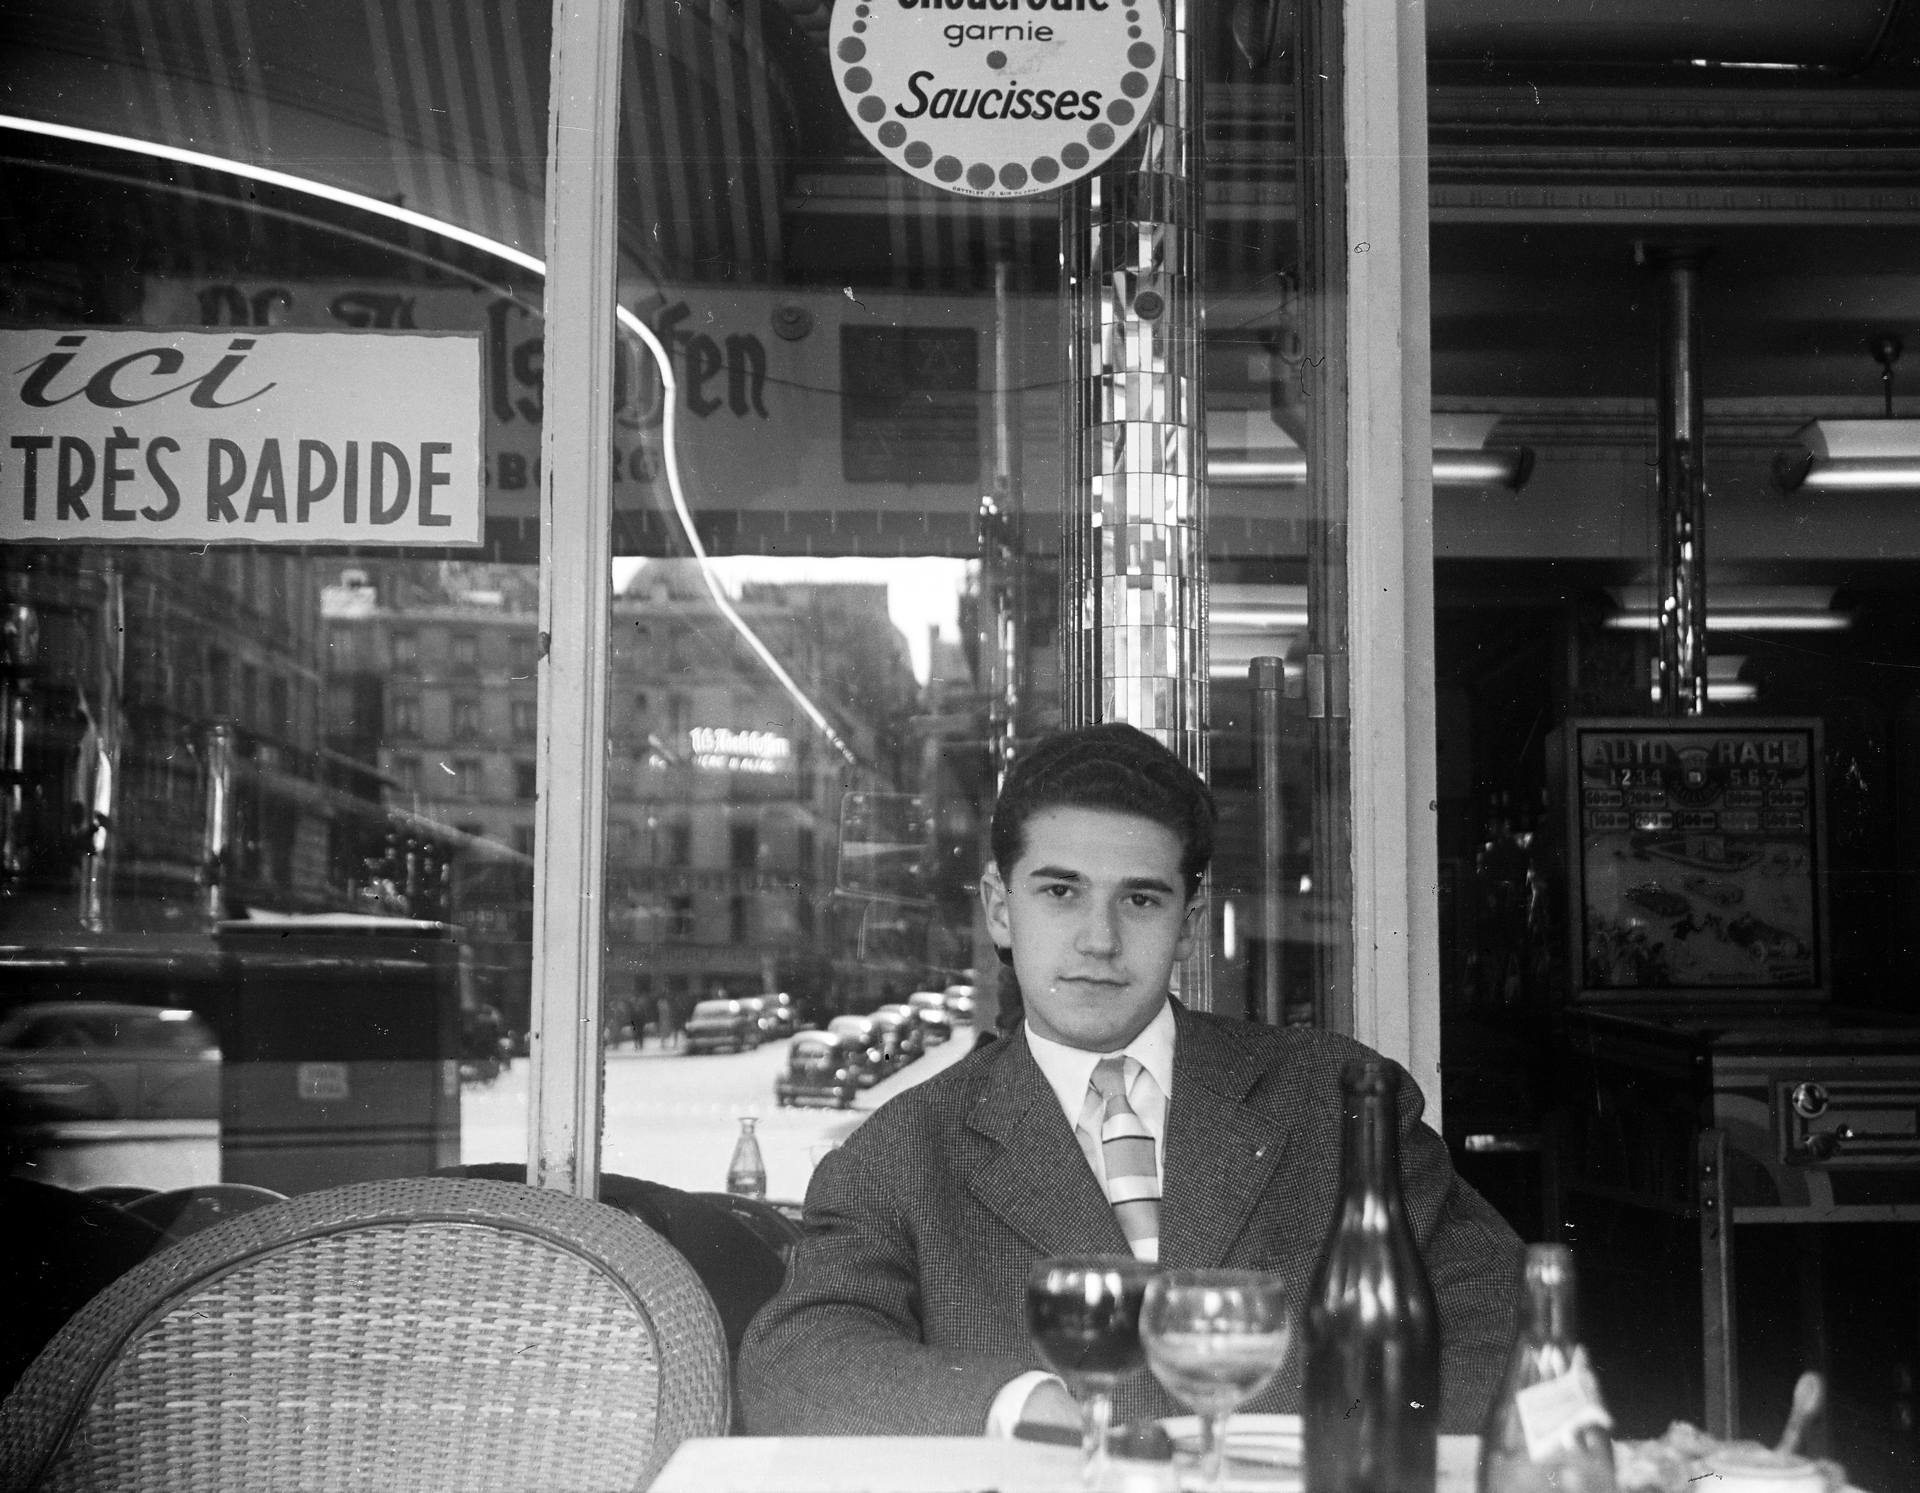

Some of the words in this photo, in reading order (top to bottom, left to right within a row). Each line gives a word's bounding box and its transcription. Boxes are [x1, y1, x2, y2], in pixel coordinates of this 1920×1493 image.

[943, 21, 1054, 48] garnie
[894, 70, 1103, 121] Saucisses
[13, 335, 278, 409] ici
[10, 426, 182, 523] TRÈS
[206, 437, 453, 527] RAPIDE
[1591, 738, 1667, 764] AUTO
[1717, 738, 1799, 764] RACE
